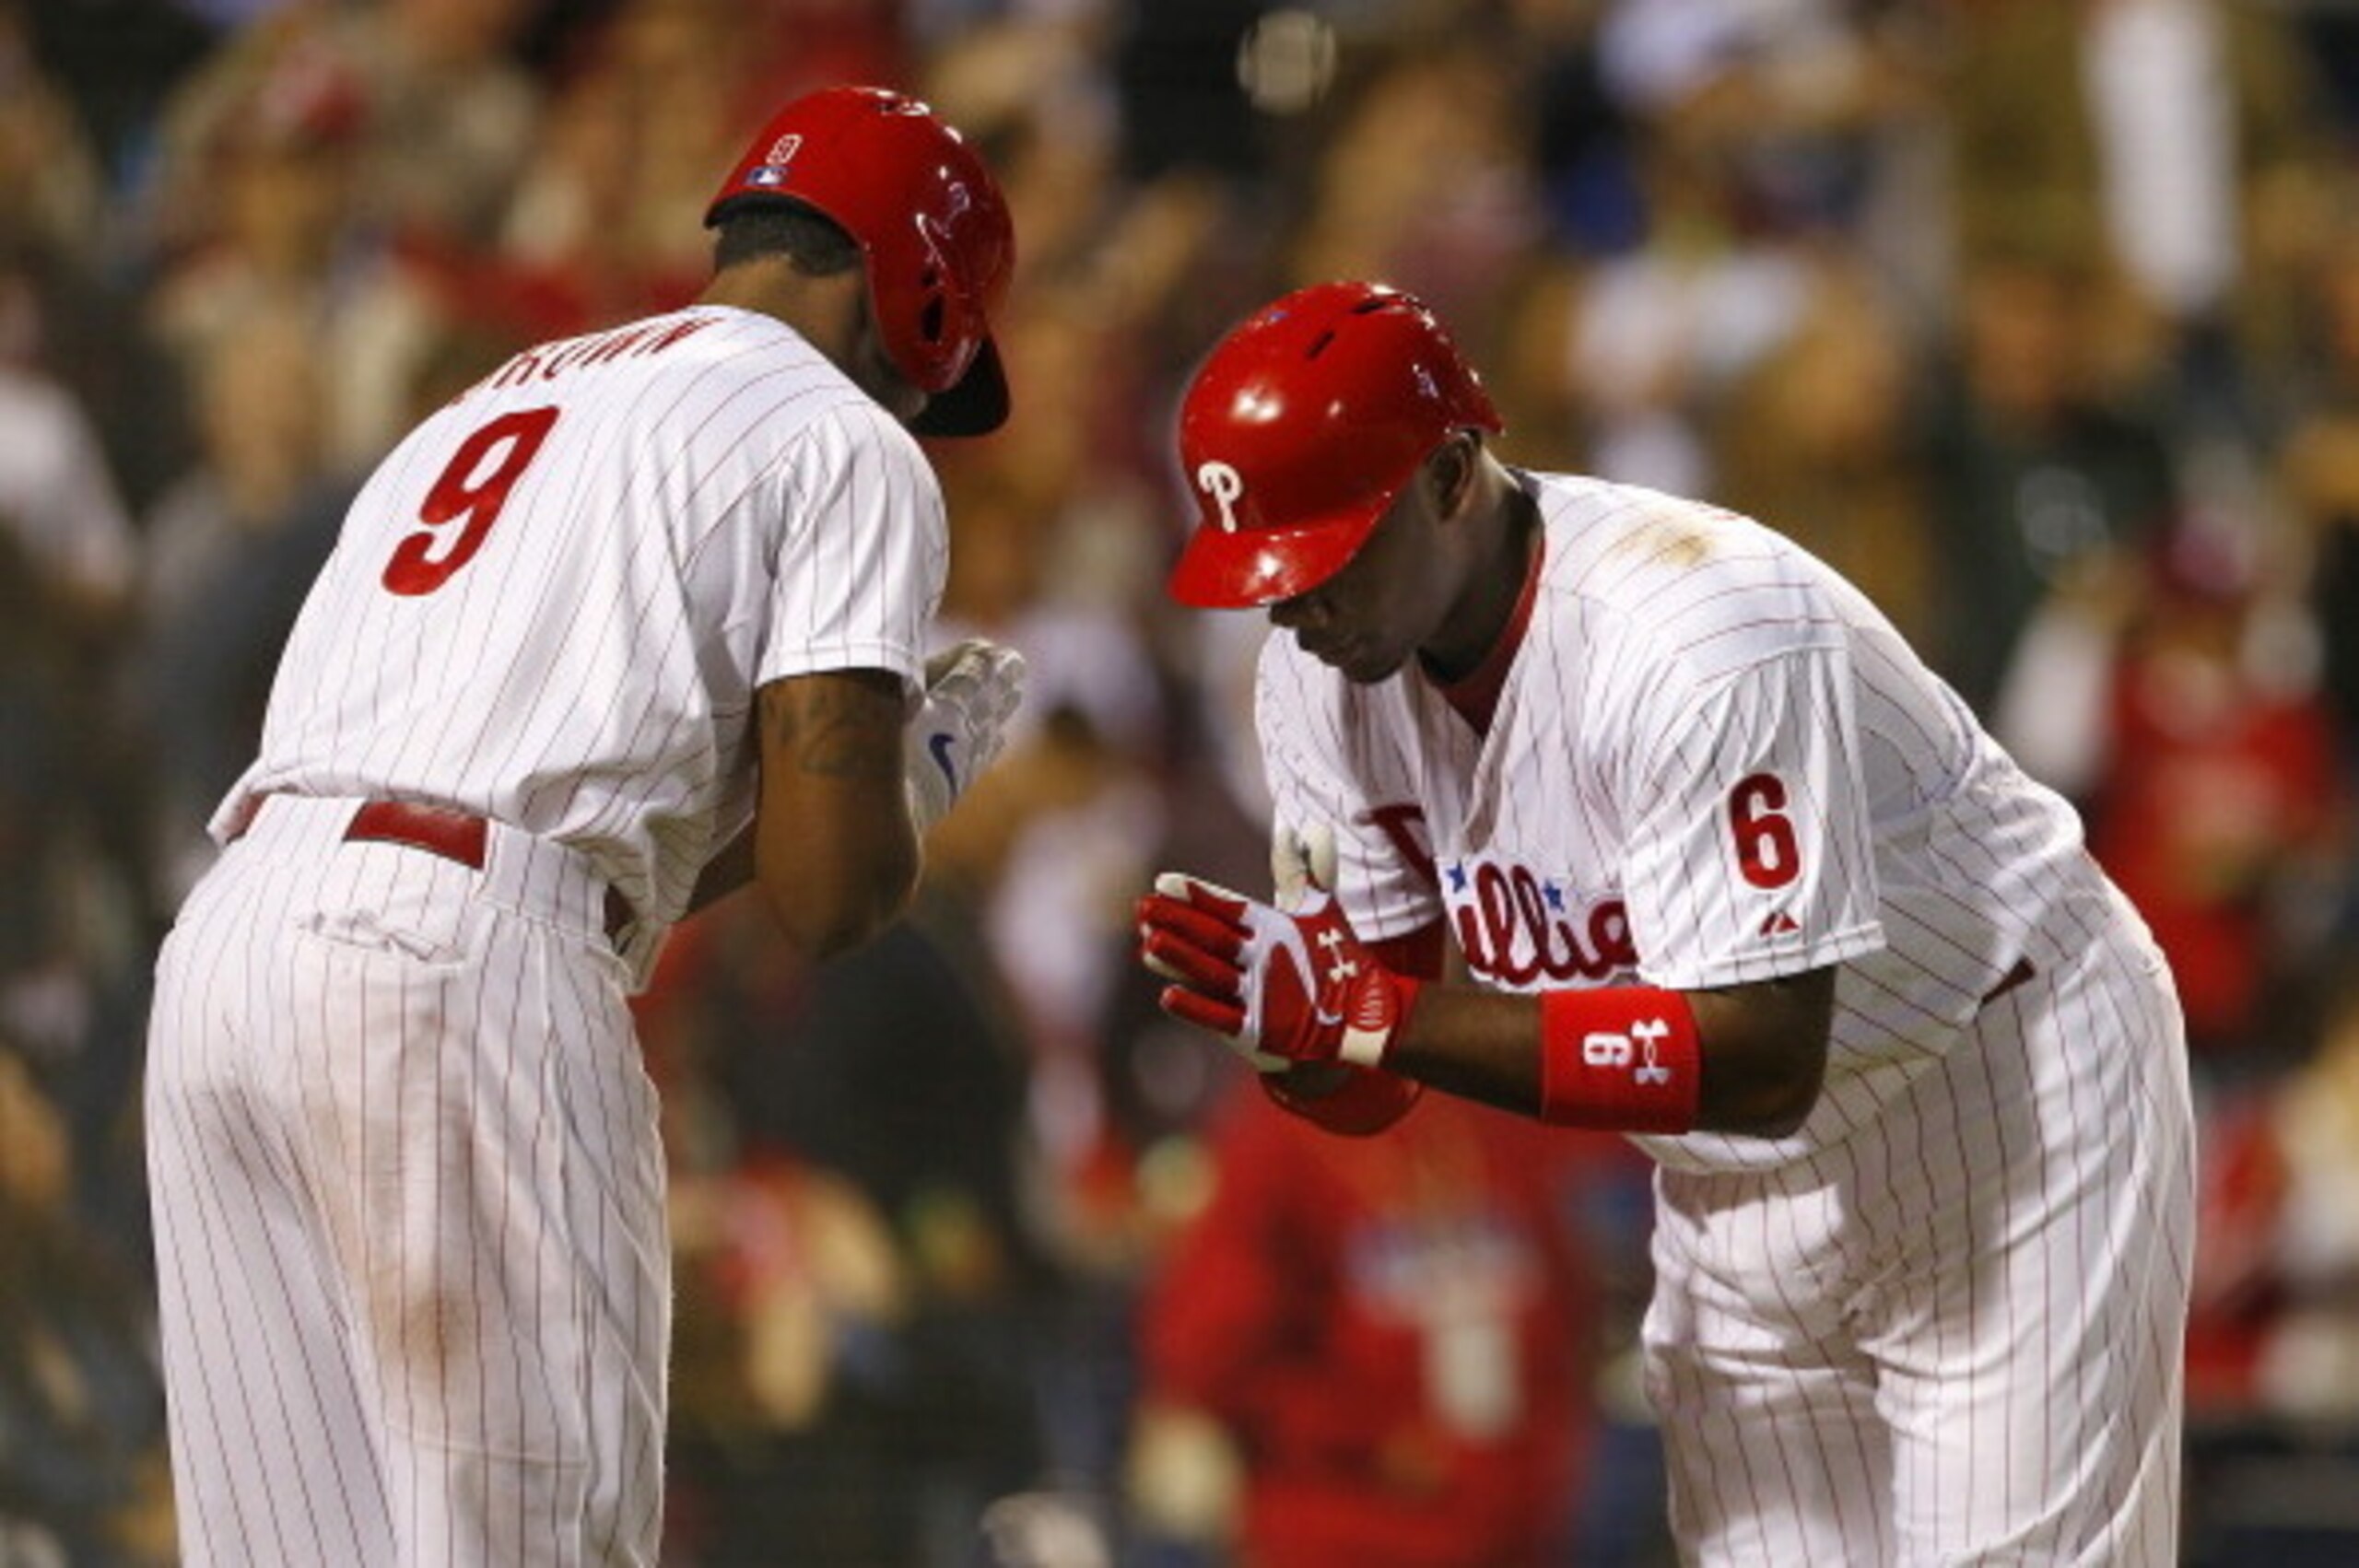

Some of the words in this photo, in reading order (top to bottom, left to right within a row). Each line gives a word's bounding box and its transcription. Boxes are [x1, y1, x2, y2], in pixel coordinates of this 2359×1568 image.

[381, 404, 560, 596] 9
[1198, 460, 1242, 534] P
[1729, 772, 1800, 890] 6
